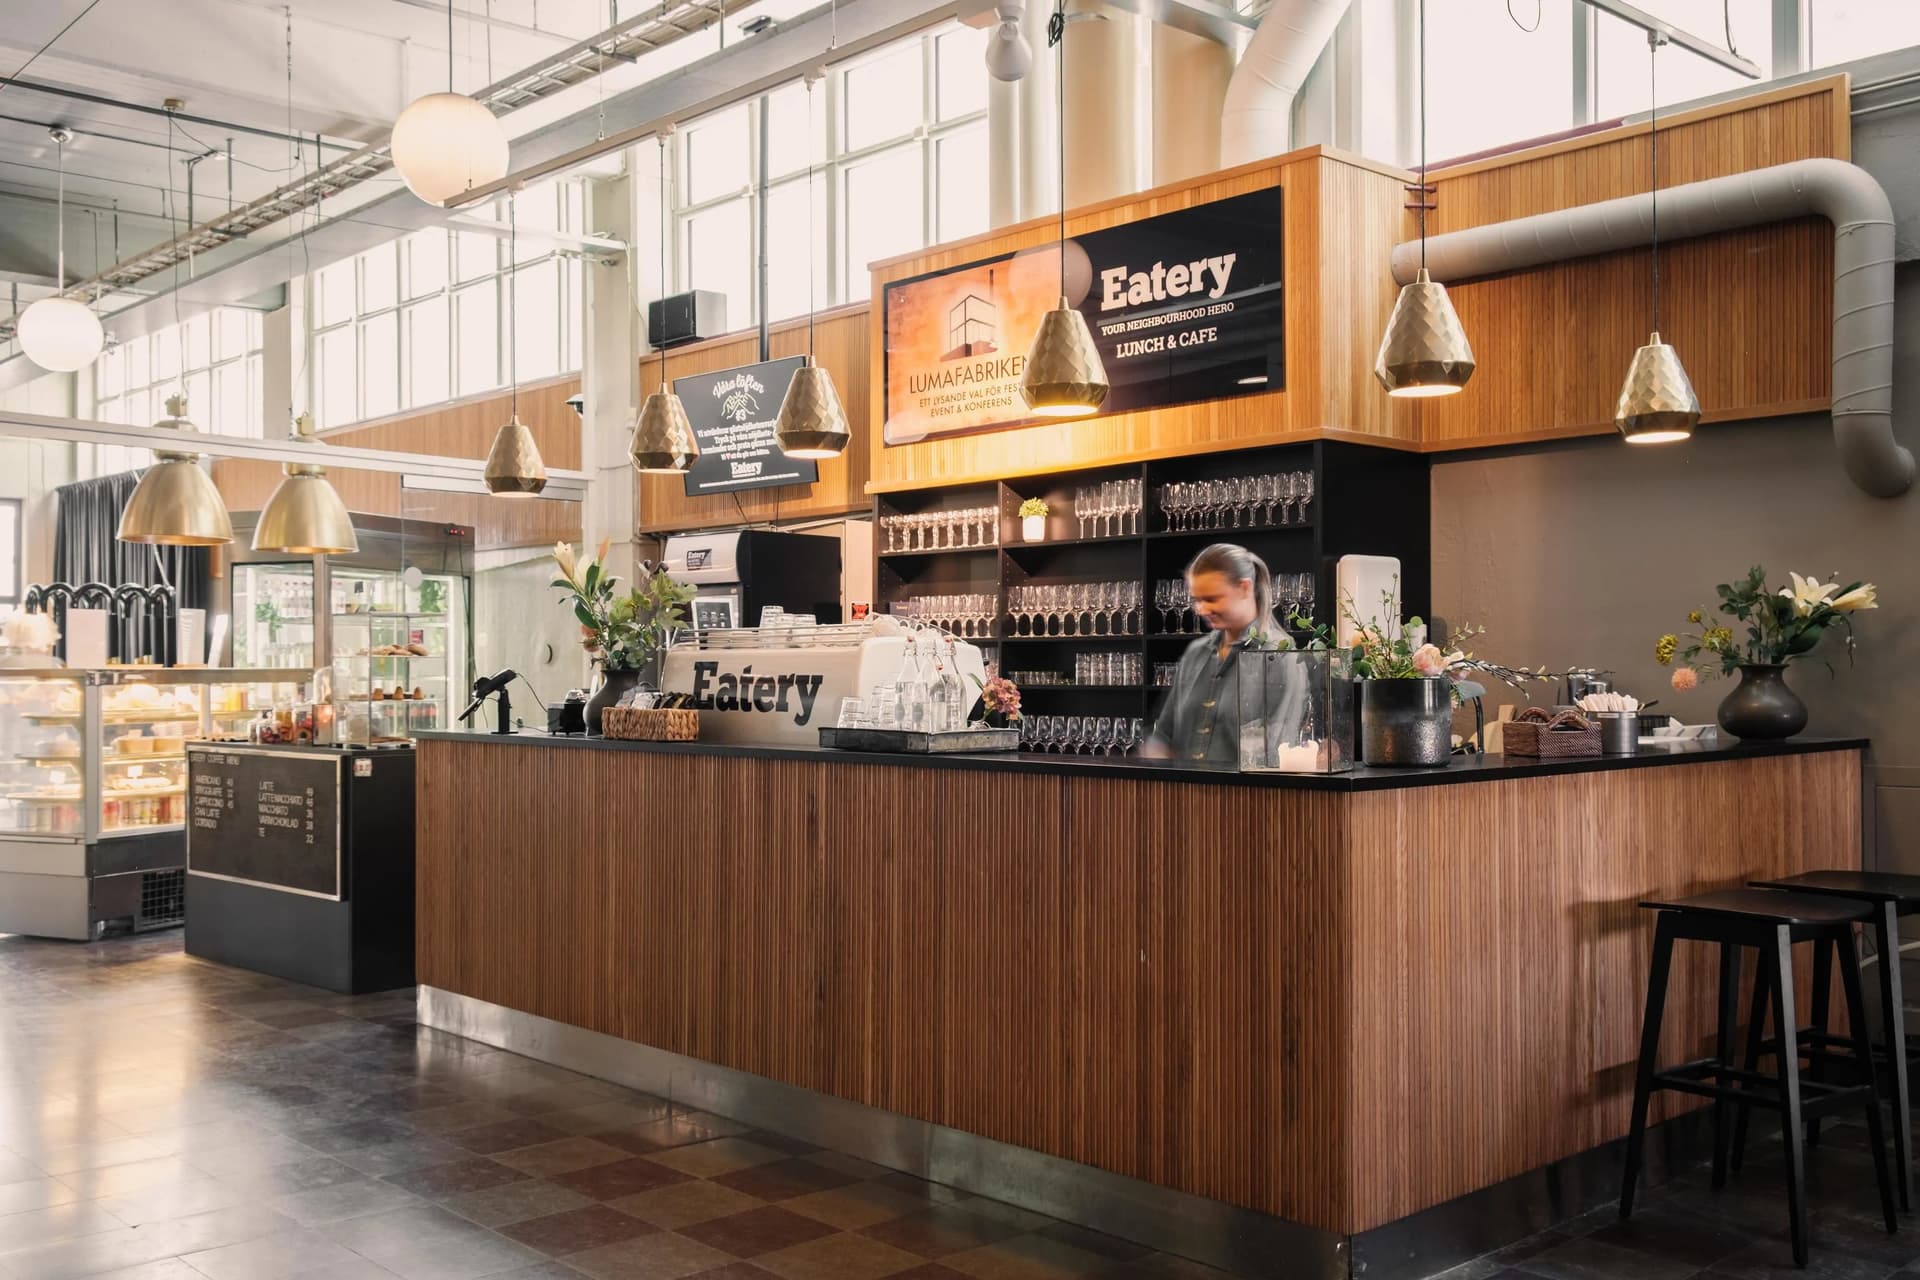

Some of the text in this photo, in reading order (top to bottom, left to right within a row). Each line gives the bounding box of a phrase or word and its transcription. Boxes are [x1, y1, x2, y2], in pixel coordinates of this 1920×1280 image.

[1101, 253, 1236, 311] Eatery
[1101, 301, 1235, 336] YOUR NEIGHBOURHOOD HERO
[1116, 327, 1217, 358] LUNCH & CAFE
[919, 382, 1020, 408] ETT LYSANDE VAL FÖR FES
[930, 398, 1013, 417] EVENT & KONFERENS
[730, 461, 763, 475] Eatery
[688, 551, 706, 560] Eatery
[693, 661, 824, 726] Eatery
[259, 780, 274, 791] LATTE
